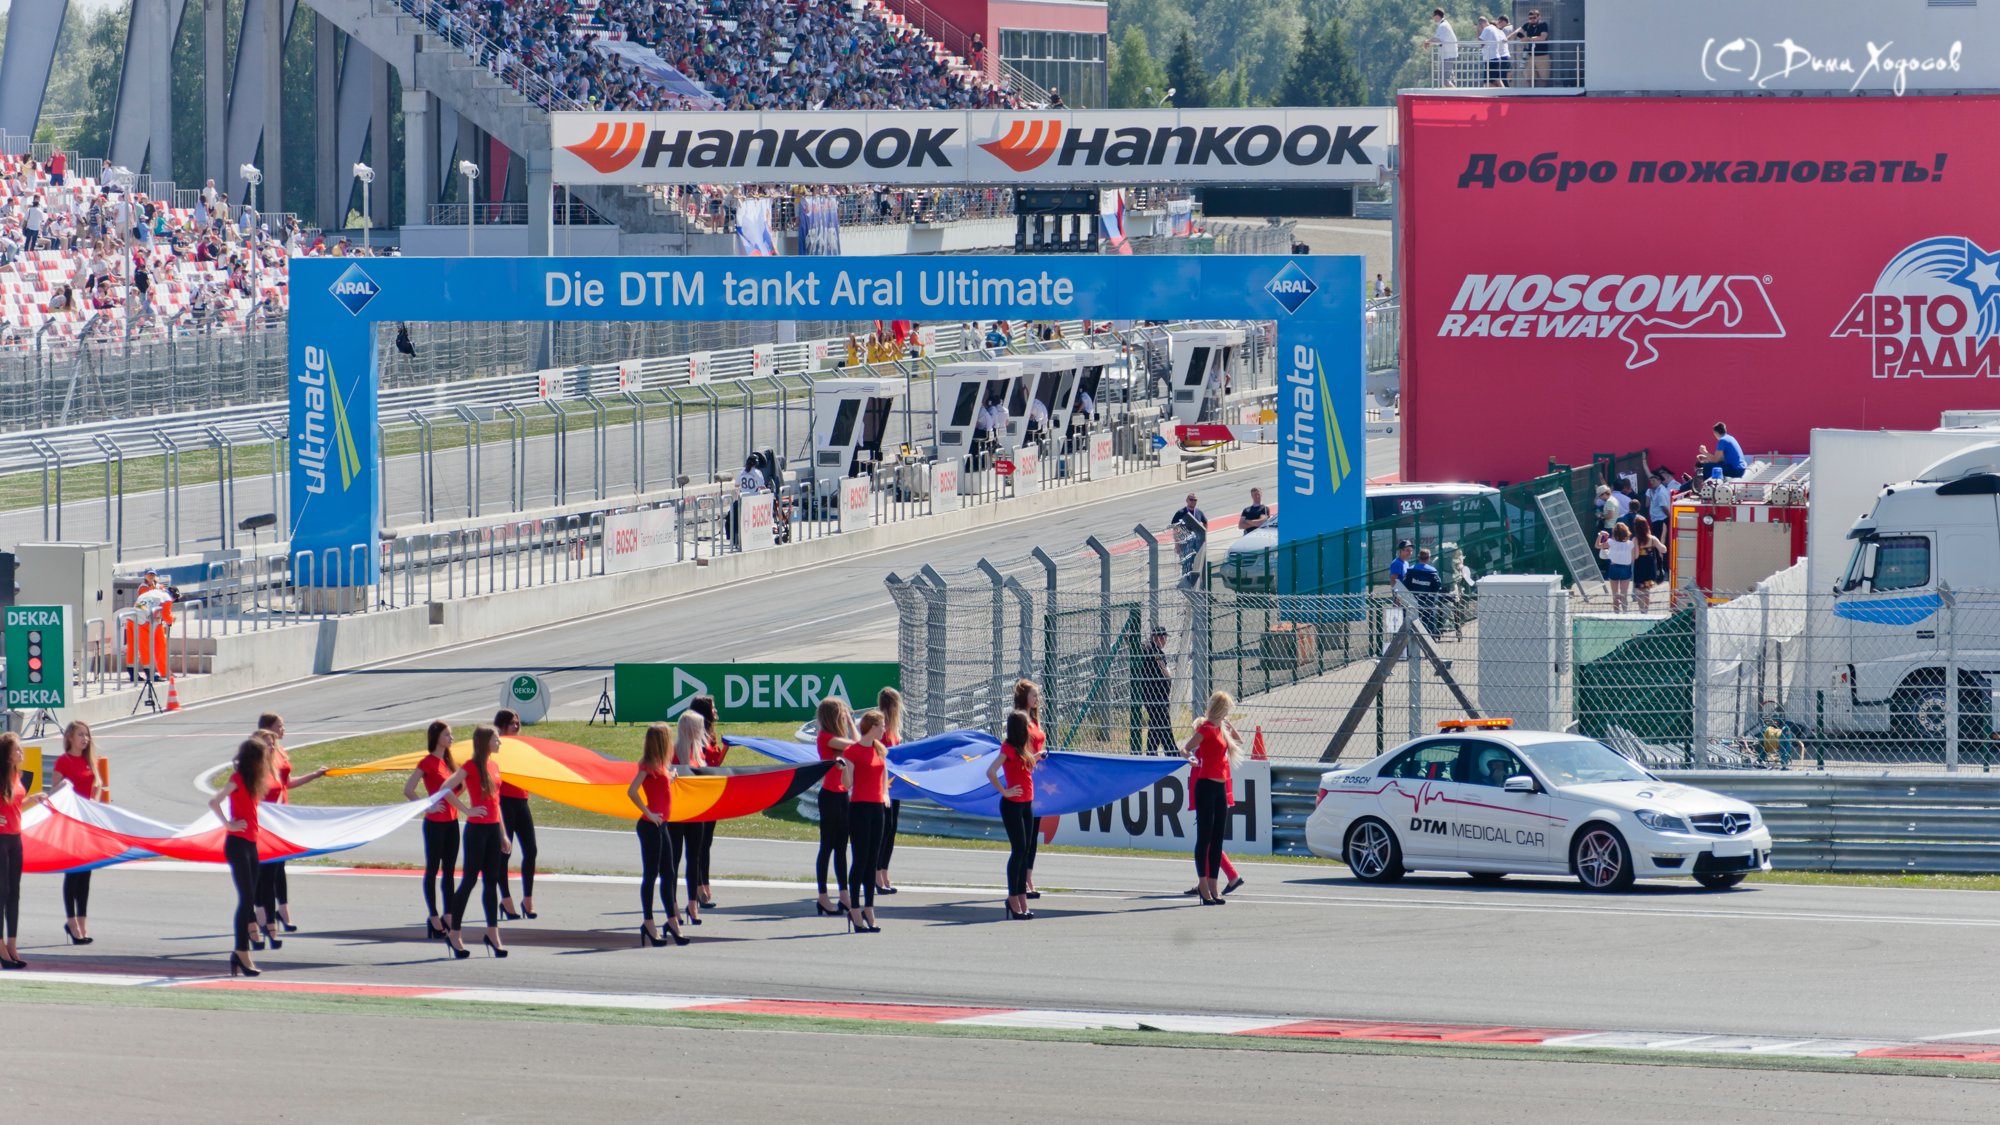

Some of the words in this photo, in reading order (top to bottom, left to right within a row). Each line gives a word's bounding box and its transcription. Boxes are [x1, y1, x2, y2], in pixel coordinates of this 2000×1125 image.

[1457, 152, 1618, 191] Добро
[1627, 153, 1949, 184] пожаловать!
[335, 281, 375, 295] ARAL
[545, 271, 604, 307] Die
[620, 271, 705, 307] DTM
[723, 271, 820, 306] tankt
[830, 271, 903, 306] Aral
[919, 270, 1074, 306] Ultimate
[1271, 280, 1312, 294] ARAL
[1450, 274, 1725, 313] MOSCOW
[1437, 314, 1626, 338] RACEWAY
[1831, 294, 1968, 336] АВТО
[1873, 335, 2000, 378] РАДИ
[298, 345, 326, 495] ultimate
[1286, 344, 1315, 496] ultimate
[741, 477, 756, 490] 80
[850, 485, 869, 510] BOSCH
[751, 503, 772, 528] BOSCH
[616, 528, 638, 555] BOSCH
[7, 611, 60, 626] DEKRA
[9, 689, 62, 704] DEKRA
[724, 674, 853, 709] DEKRA
[1342, 776, 1372, 785] BOSCH
[1410, 817, 1448, 836] DTM
[1452, 822, 1512, 844] MEDICAL
[1516, 830, 1545, 848] CAR
